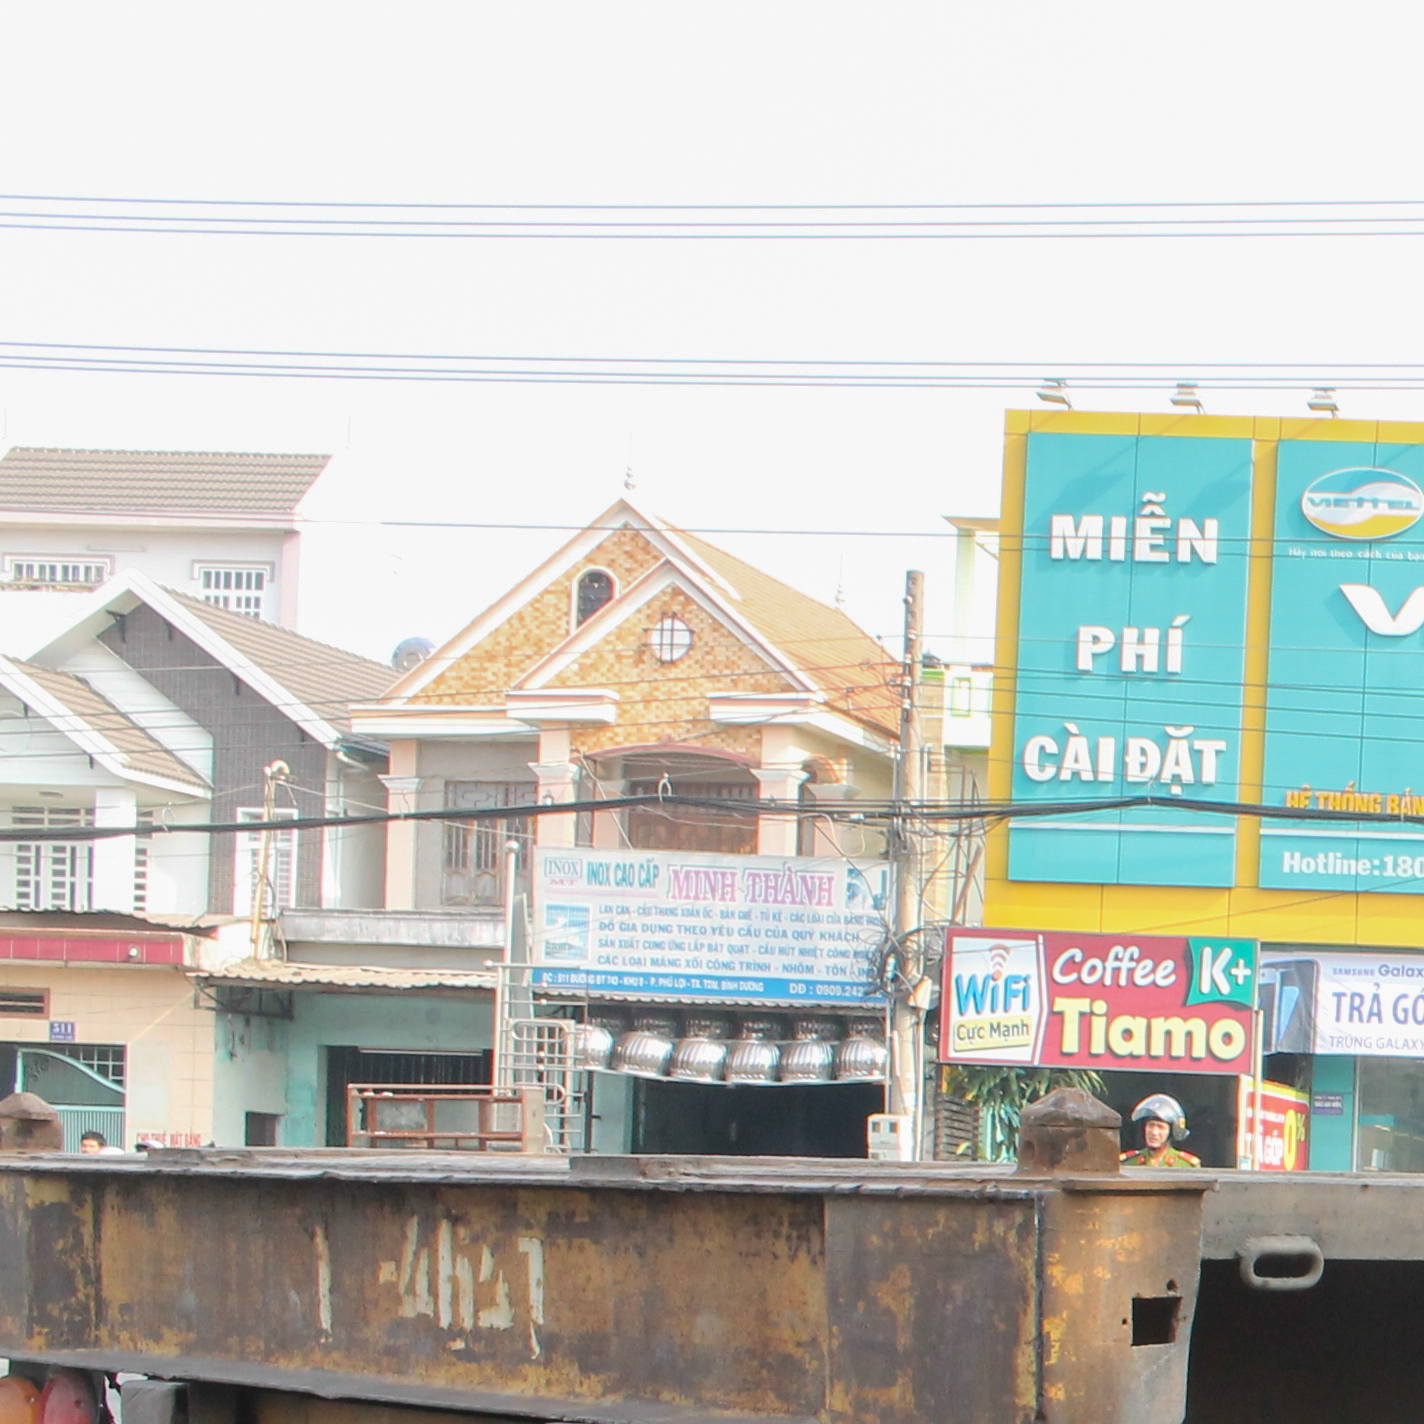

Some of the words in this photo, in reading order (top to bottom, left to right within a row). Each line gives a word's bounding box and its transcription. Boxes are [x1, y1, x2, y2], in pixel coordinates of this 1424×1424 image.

[1049, 491, 1219, 564] MIỄN
[1076, 614, 1192, 674] PHÍ
[1022, 722, 1115, 784] CÀI
[1124, 726, 1227, 796] ĐẶT
[1315, 781, 1382, 814] THỐNG
[549, 860, 579, 876] INOX
[586, 861, 611, 887] INOX
[614, 862, 635, 888] CAO
[638, 857, 659, 888] CẤP
[670, 866, 739, 903] MINH
[745, 863, 836, 907] THÀNH
[677, 924, 707, 936] THEO
[819, 928, 860, 942] KHÁCH
[1052, 945, 1177, 988] Coffee
[1199, 946, 1252, 995] K+
[1332, 967, 1375, 976] SAMSUNG
[954, 973, 1032, 1016] WiFi
[1332, 982, 1383, 1024] TRẢ
[956, 1022, 985, 1045] Cực
[990, 1021, 1030, 1043] Mạnh
[1053, 996, 1246, 1061] Tiamo
